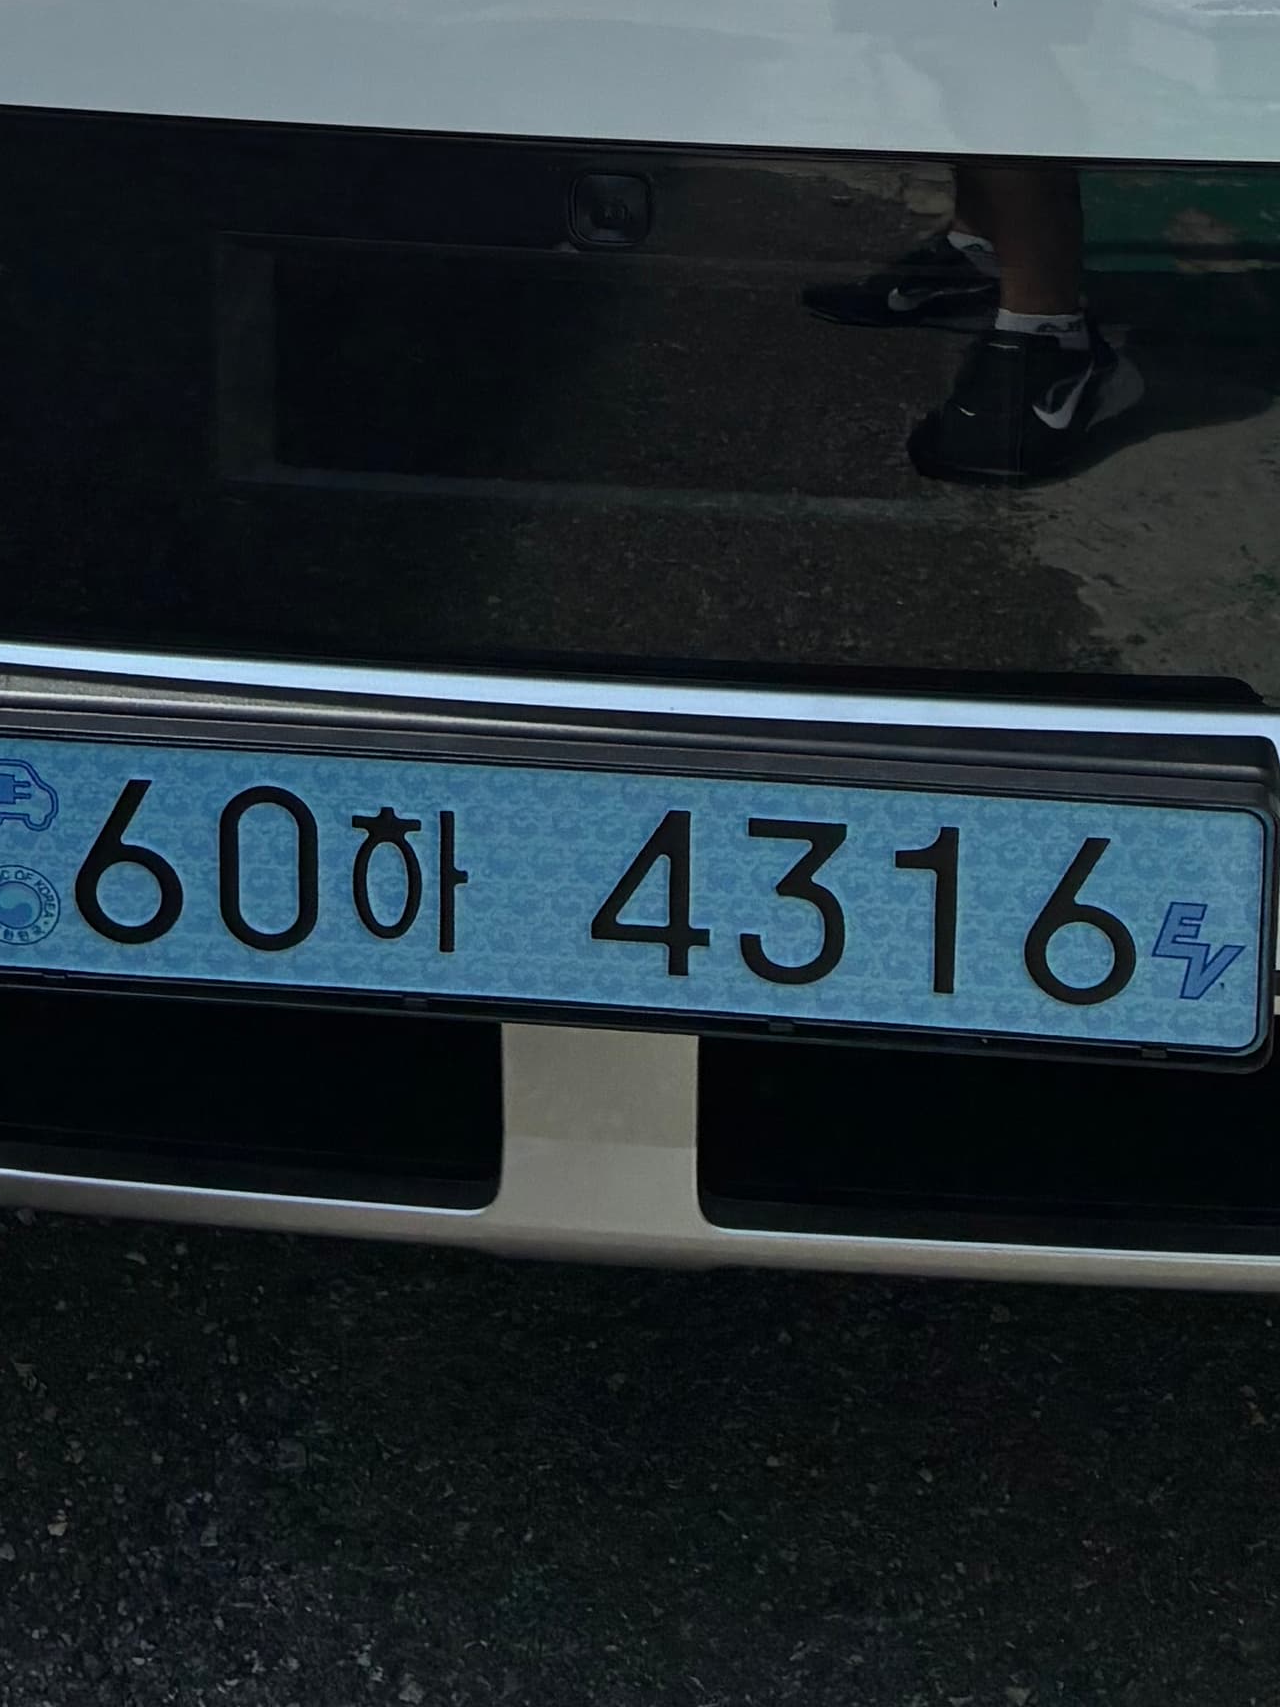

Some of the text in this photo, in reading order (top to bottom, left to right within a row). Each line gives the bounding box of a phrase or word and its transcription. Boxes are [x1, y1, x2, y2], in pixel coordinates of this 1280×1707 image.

[13, 869, 34, 882] OF
[35, 879, 57, 919] KOREA
[74, 777, 1140, 1007] 60하 4316
[1151, 900, 1245, 1000] EV
